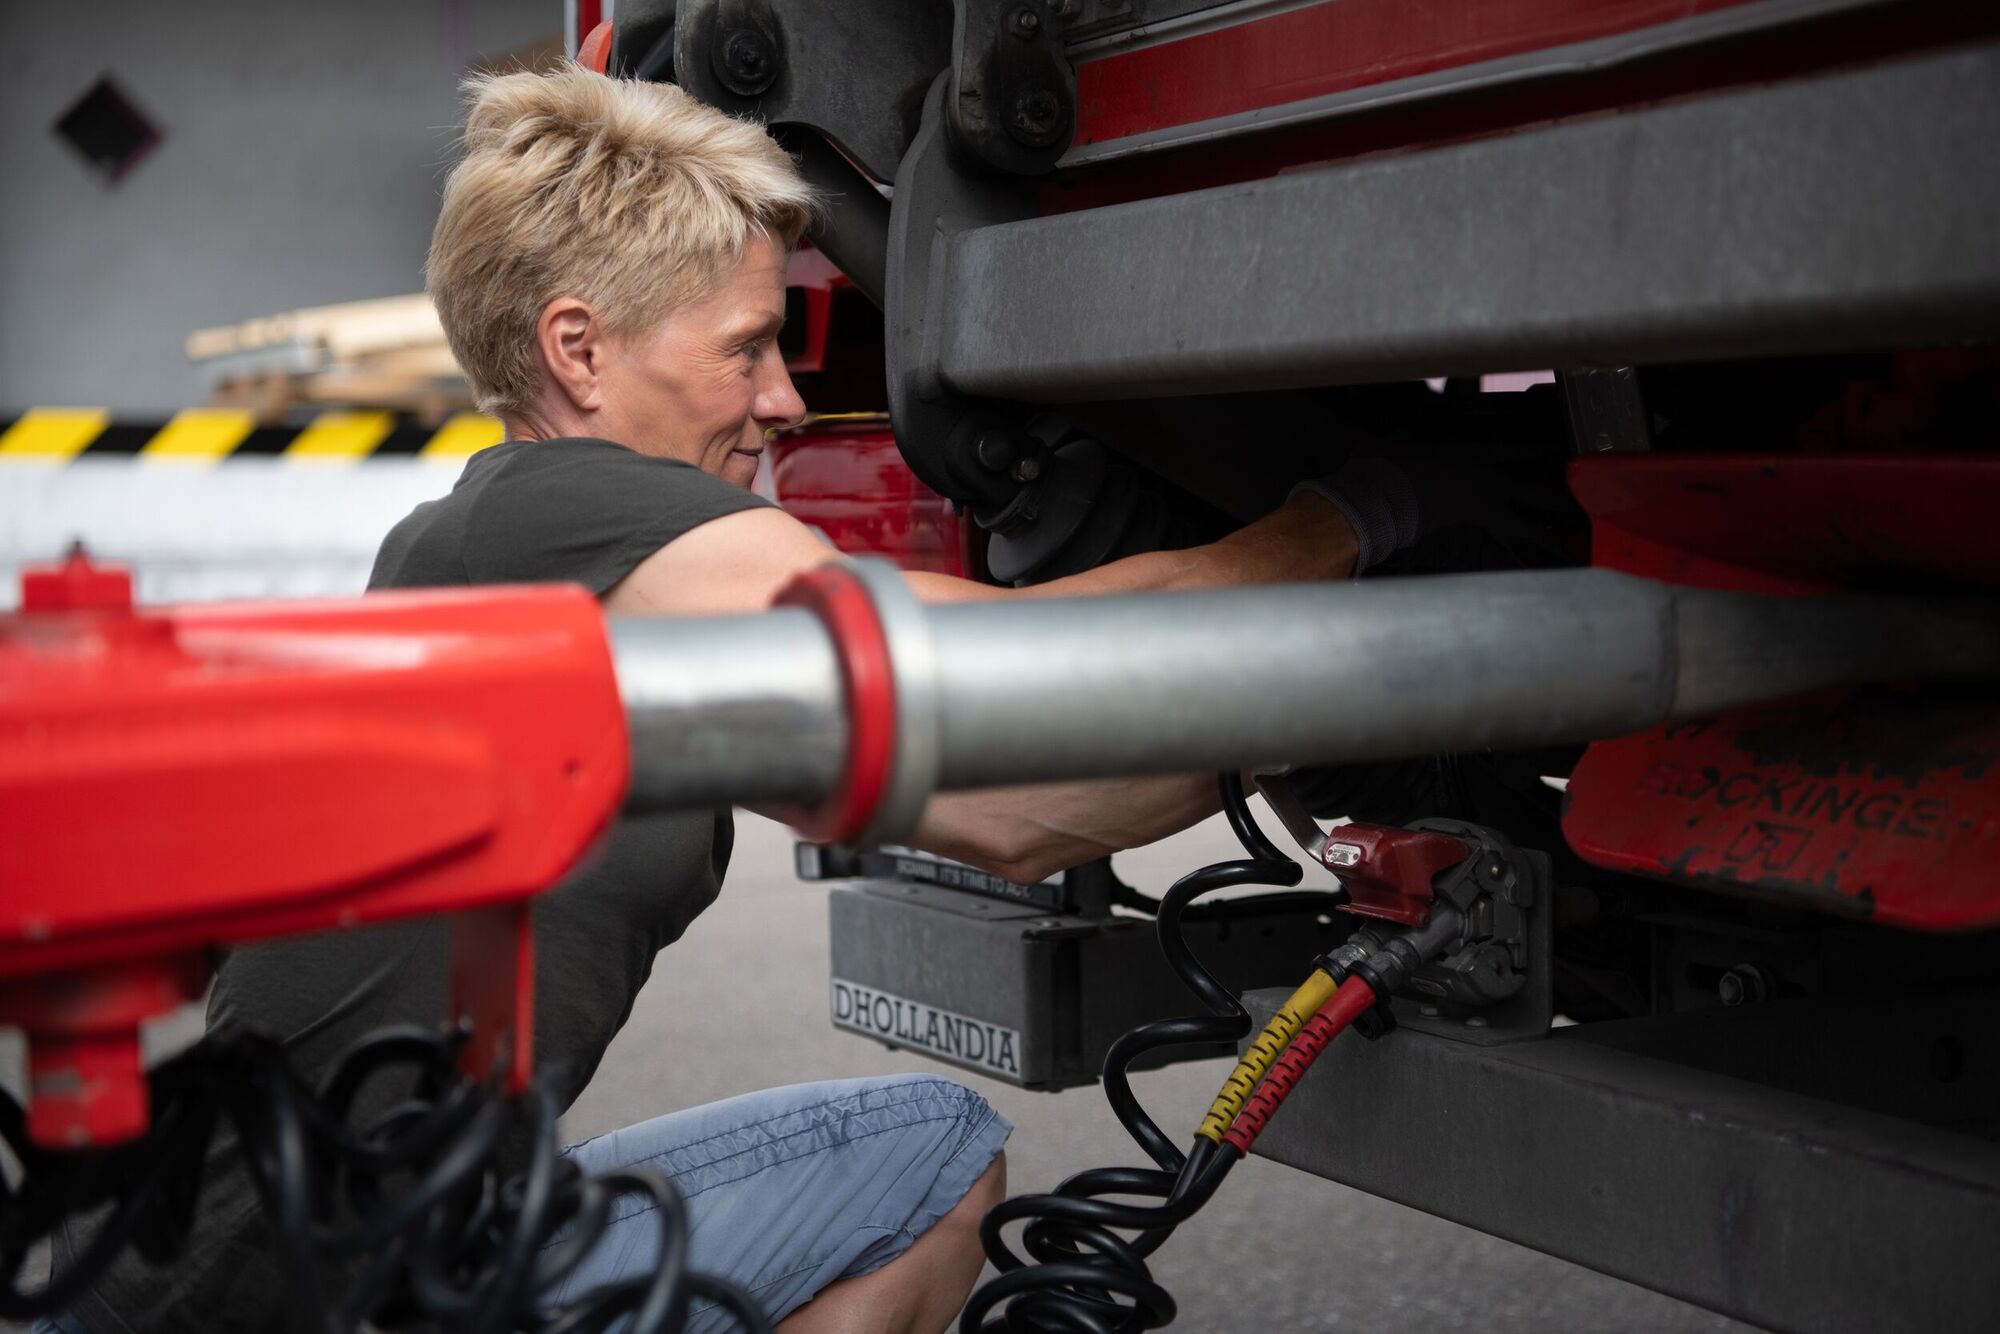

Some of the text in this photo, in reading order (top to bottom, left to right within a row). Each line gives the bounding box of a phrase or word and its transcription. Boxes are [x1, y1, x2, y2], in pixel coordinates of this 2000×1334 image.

[1638, 760, 1962, 838] ROCKINGE
[963, 870, 987, 891] TIME
[990, 876, 1005, 895] TO
[833, 983, 1017, 1074] DHOLLANDIA
